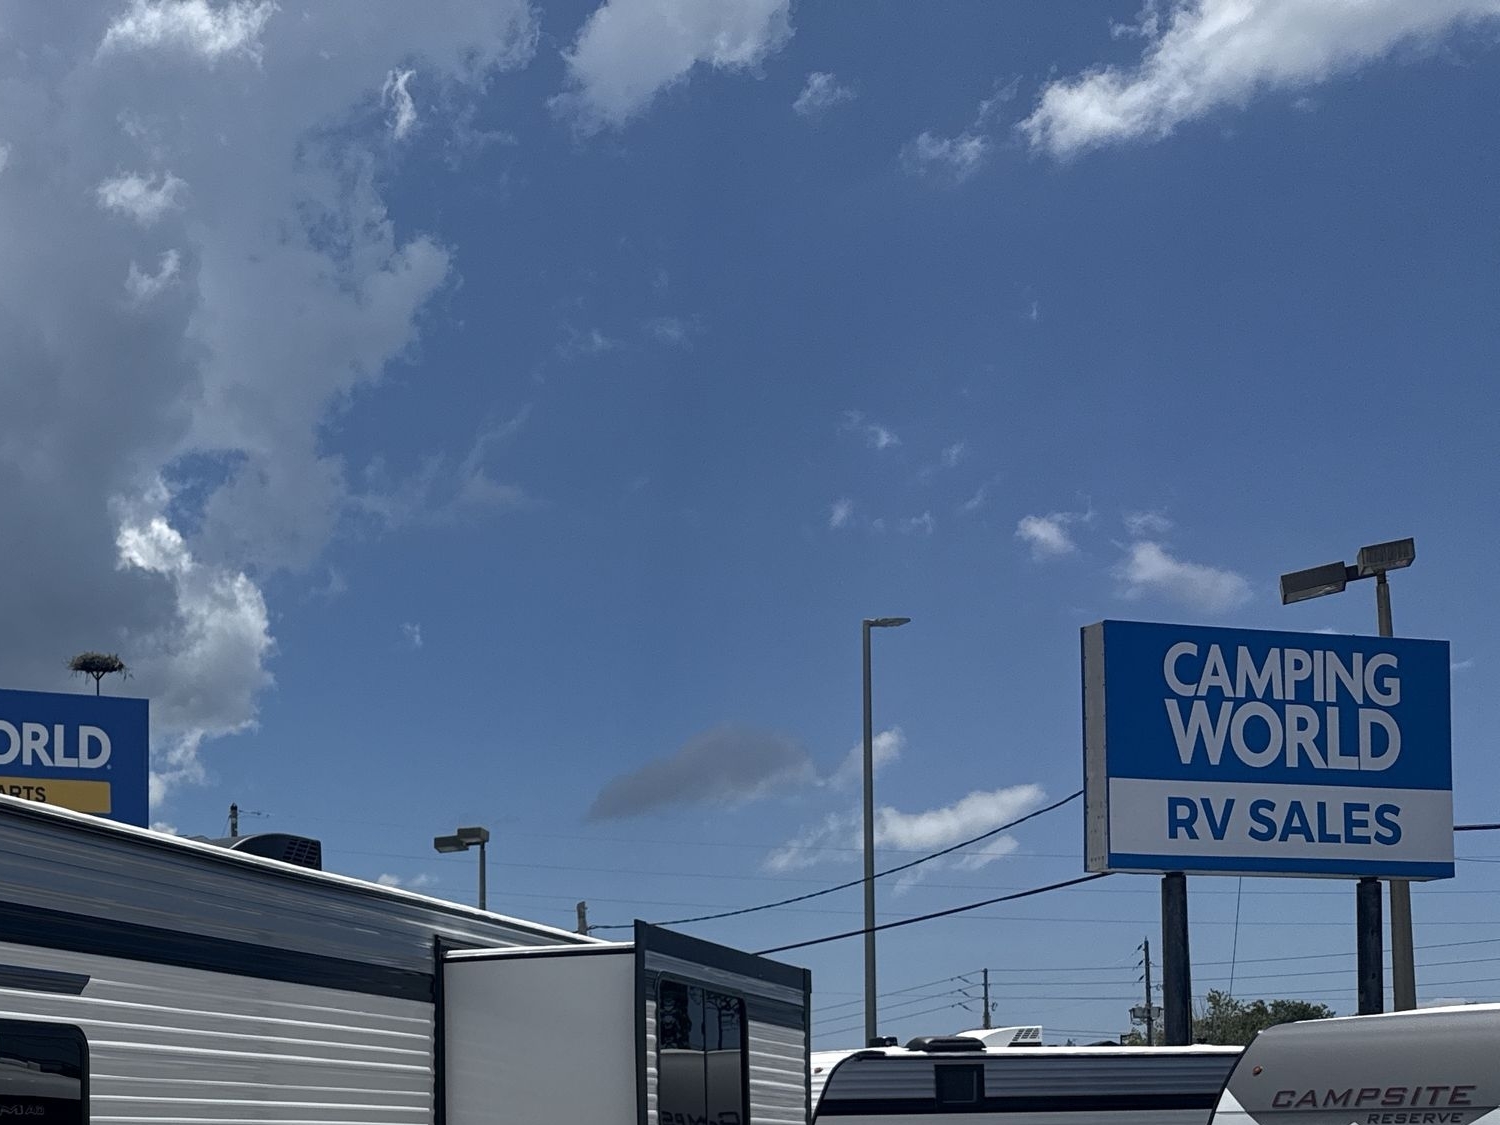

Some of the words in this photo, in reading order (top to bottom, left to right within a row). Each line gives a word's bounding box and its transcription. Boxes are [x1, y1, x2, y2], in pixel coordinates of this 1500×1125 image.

[1163, 641, 1400, 706] CAMPING
[1164, 699, 1401, 771] WORLD
[1167, 796, 1235, 840] RV
[1248, 799, 1402, 845] SALES
[1272, 1085, 1477, 1109] CAMPSITE
[1367, 1112, 1464, 1125] RESERVE
